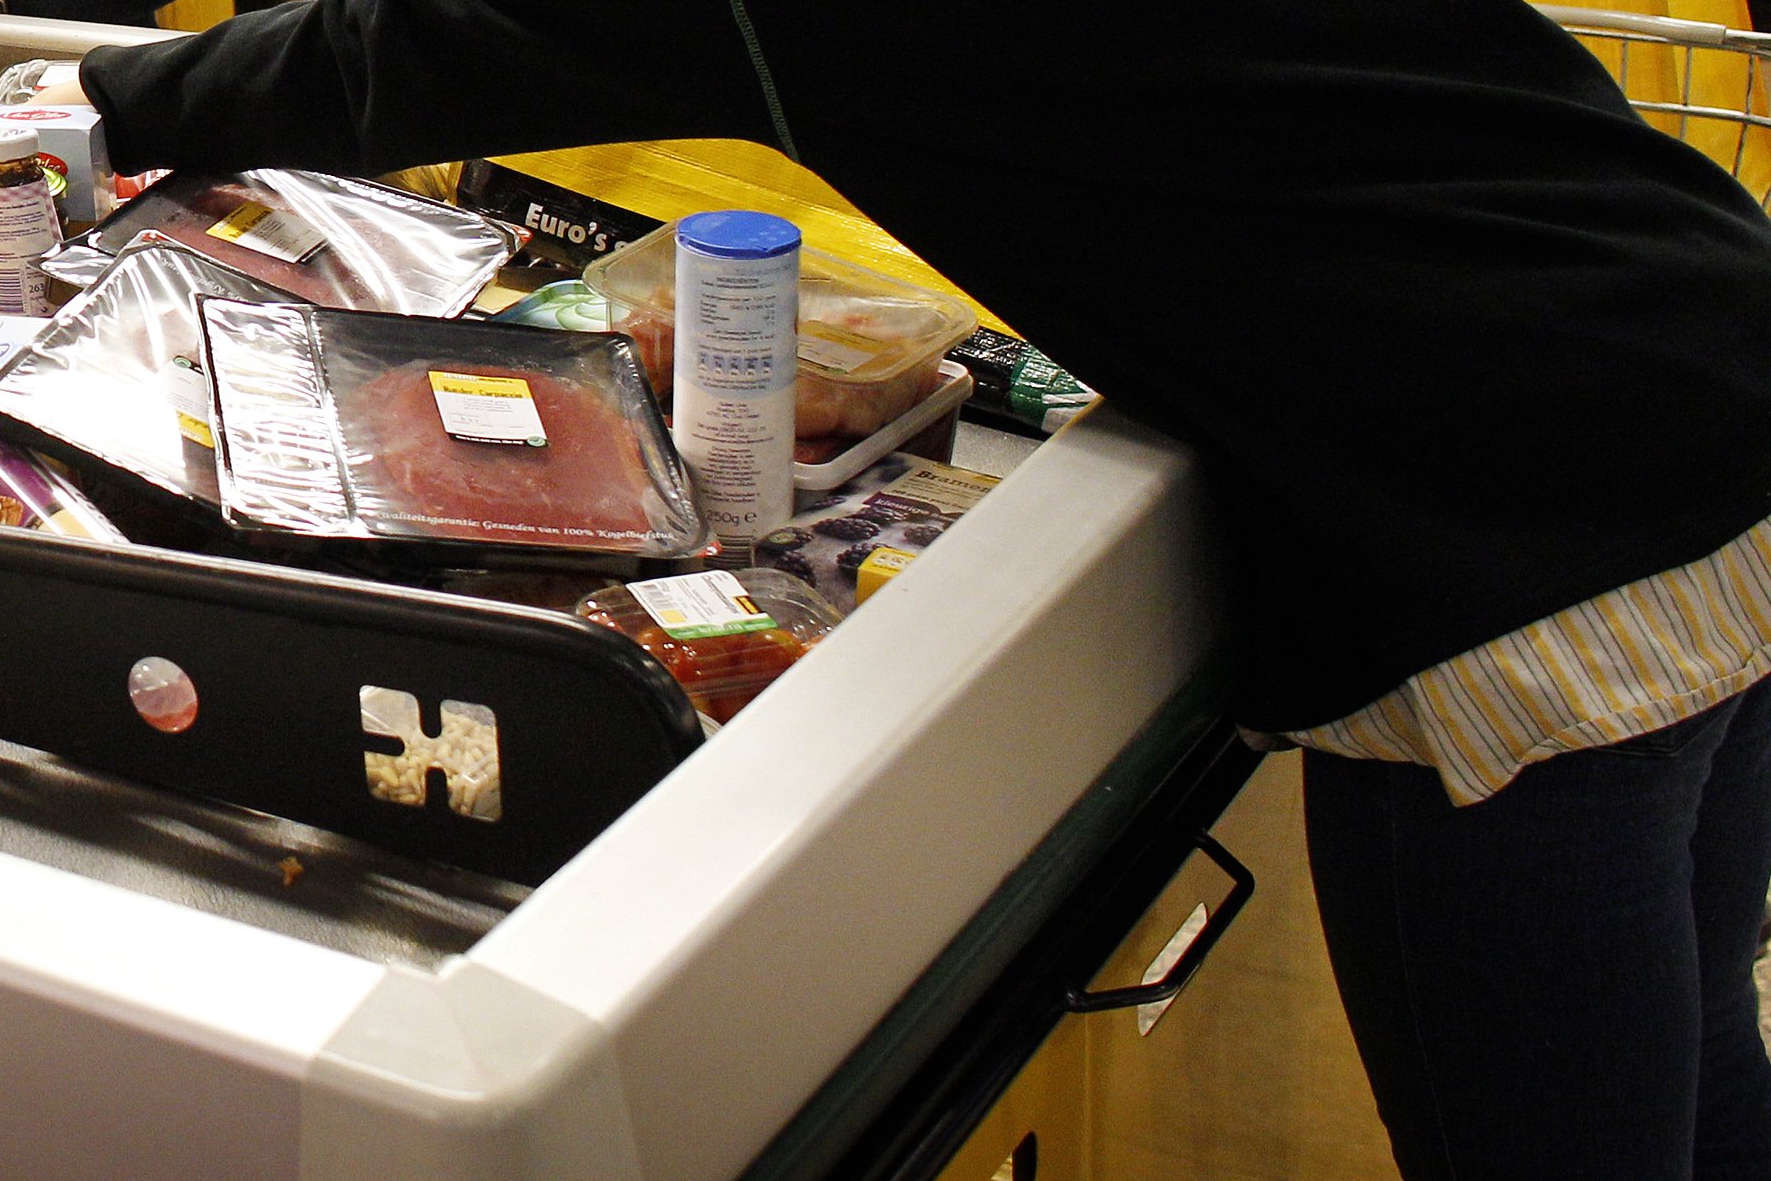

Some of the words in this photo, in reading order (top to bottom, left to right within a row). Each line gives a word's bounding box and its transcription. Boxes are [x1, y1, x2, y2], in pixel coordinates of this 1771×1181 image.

[524, 202, 608, 254] Euro's
[705, 509, 741, 527] 250g
[482, 519, 536, 533] Gesneden
[538, 527, 560, 535] van
[563, 527, 595, 537] 100%
